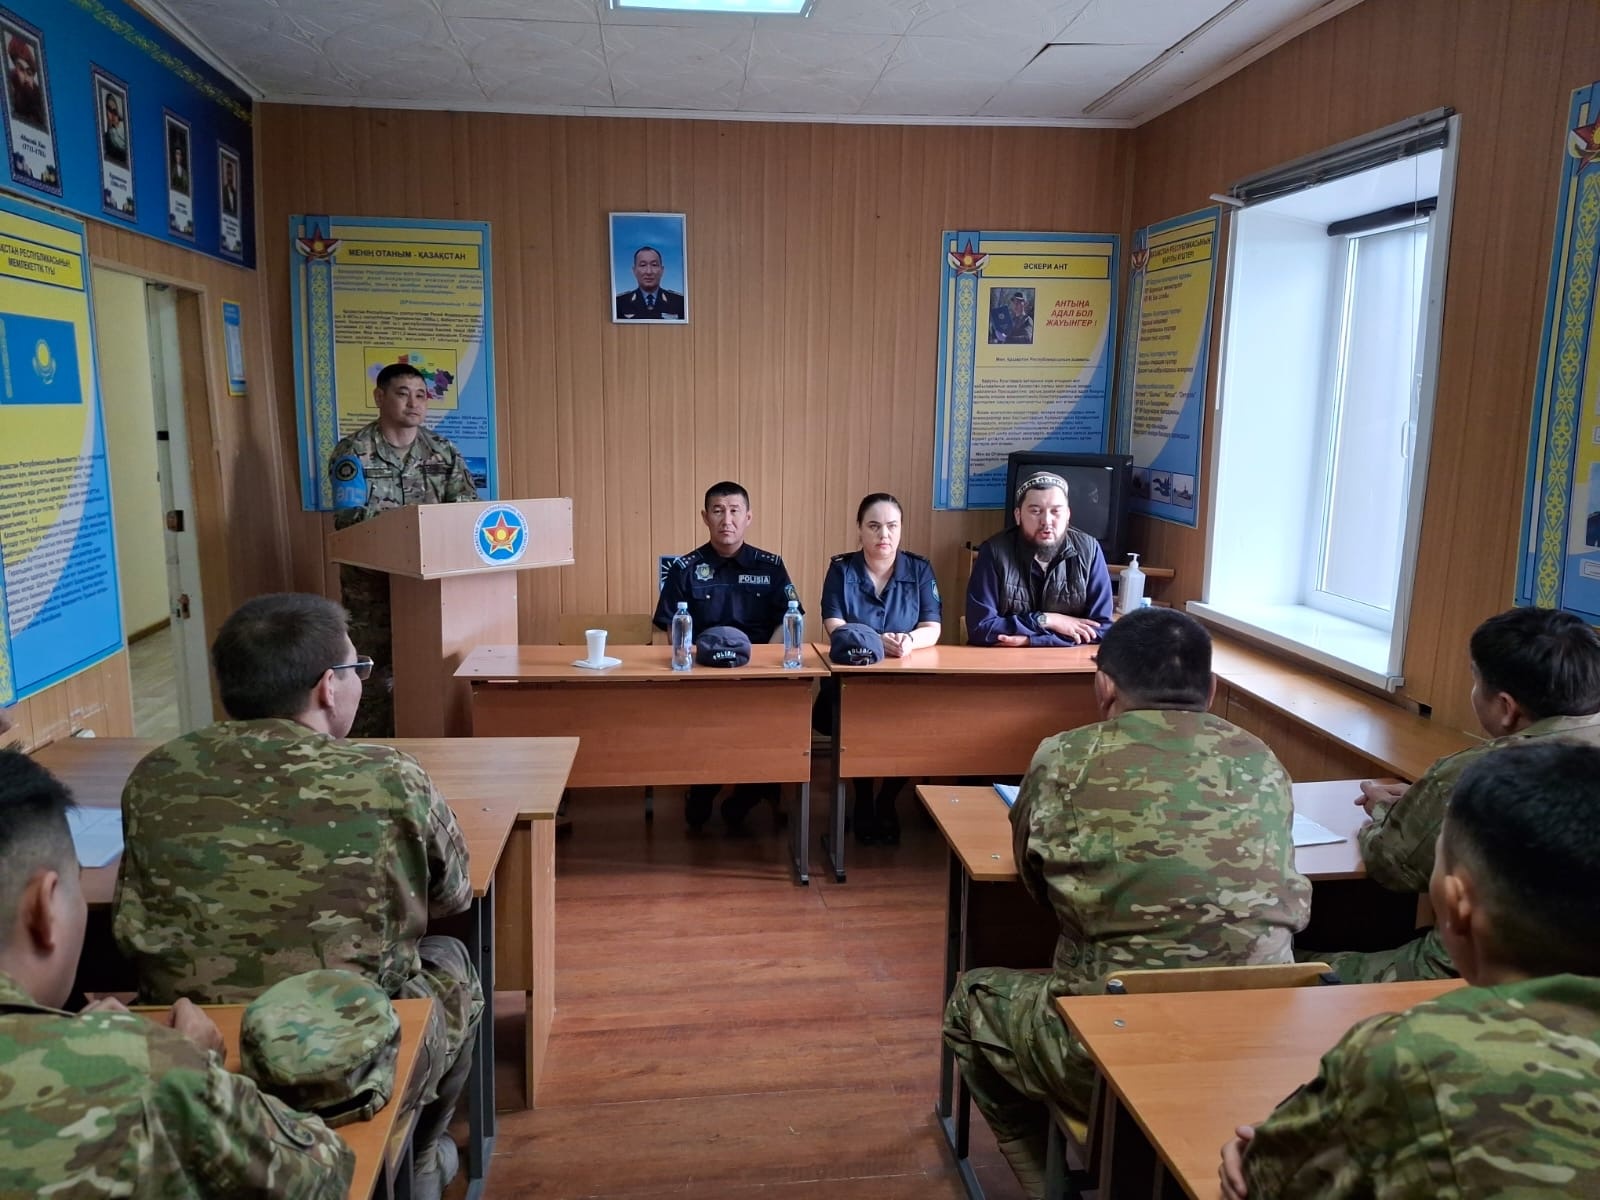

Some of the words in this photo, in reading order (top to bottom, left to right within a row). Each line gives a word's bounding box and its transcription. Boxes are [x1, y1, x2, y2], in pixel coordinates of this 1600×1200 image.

[375, 249, 412, 258] ОТАНЫМ
[418, 250, 466, 261] ҚАЗАҚСТАН
[1023, 262, 1052, 270] ӘСКЕРИ
[1053, 263, 1068, 271] АНТ
[1055, 299, 1090, 309] АНТЫҢА
[1051, 309, 1075, 318] АДАЛ
[1075, 309, 1093, 317] БОЛ
[1046, 319, 1093, 327] ЖАУЫНГЕР
[739, 574, 770, 585] POLISIA
